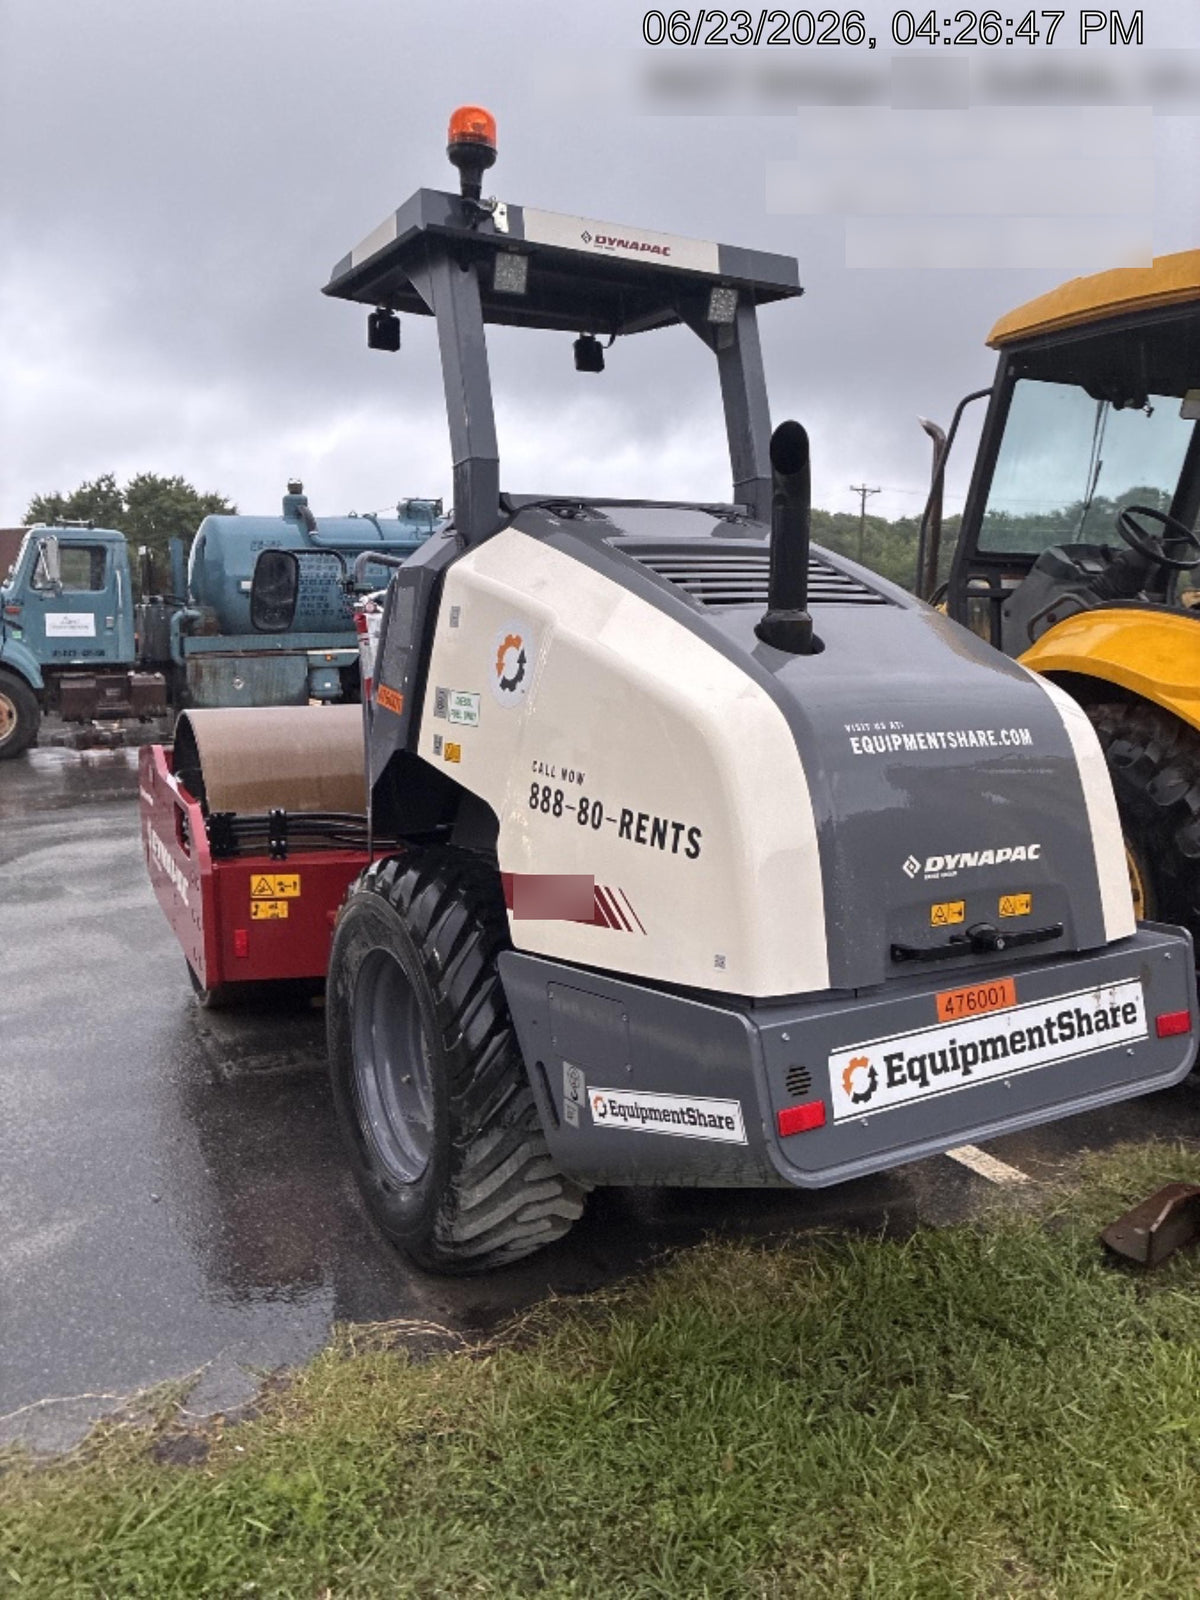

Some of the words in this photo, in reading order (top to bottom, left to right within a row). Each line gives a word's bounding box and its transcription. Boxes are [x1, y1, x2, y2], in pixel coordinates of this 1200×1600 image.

[594, 234, 671, 257] DYNAPAC
[850, 728, 1034, 755] EQUIPMENTSHARE.COM
[532, 760, 556, 778] CALL
[561, 767, 586, 786] NOW
[529, 782, 702, 859] 888-80-RENTS
[924, 844, 1041, 873] DYNAPAC
[945, 985, 1007, 1015] 476001
[884, 1001, 1138, 1088] EquipmentShare
[608, 1099, 736, 1130] EquipmentShare
